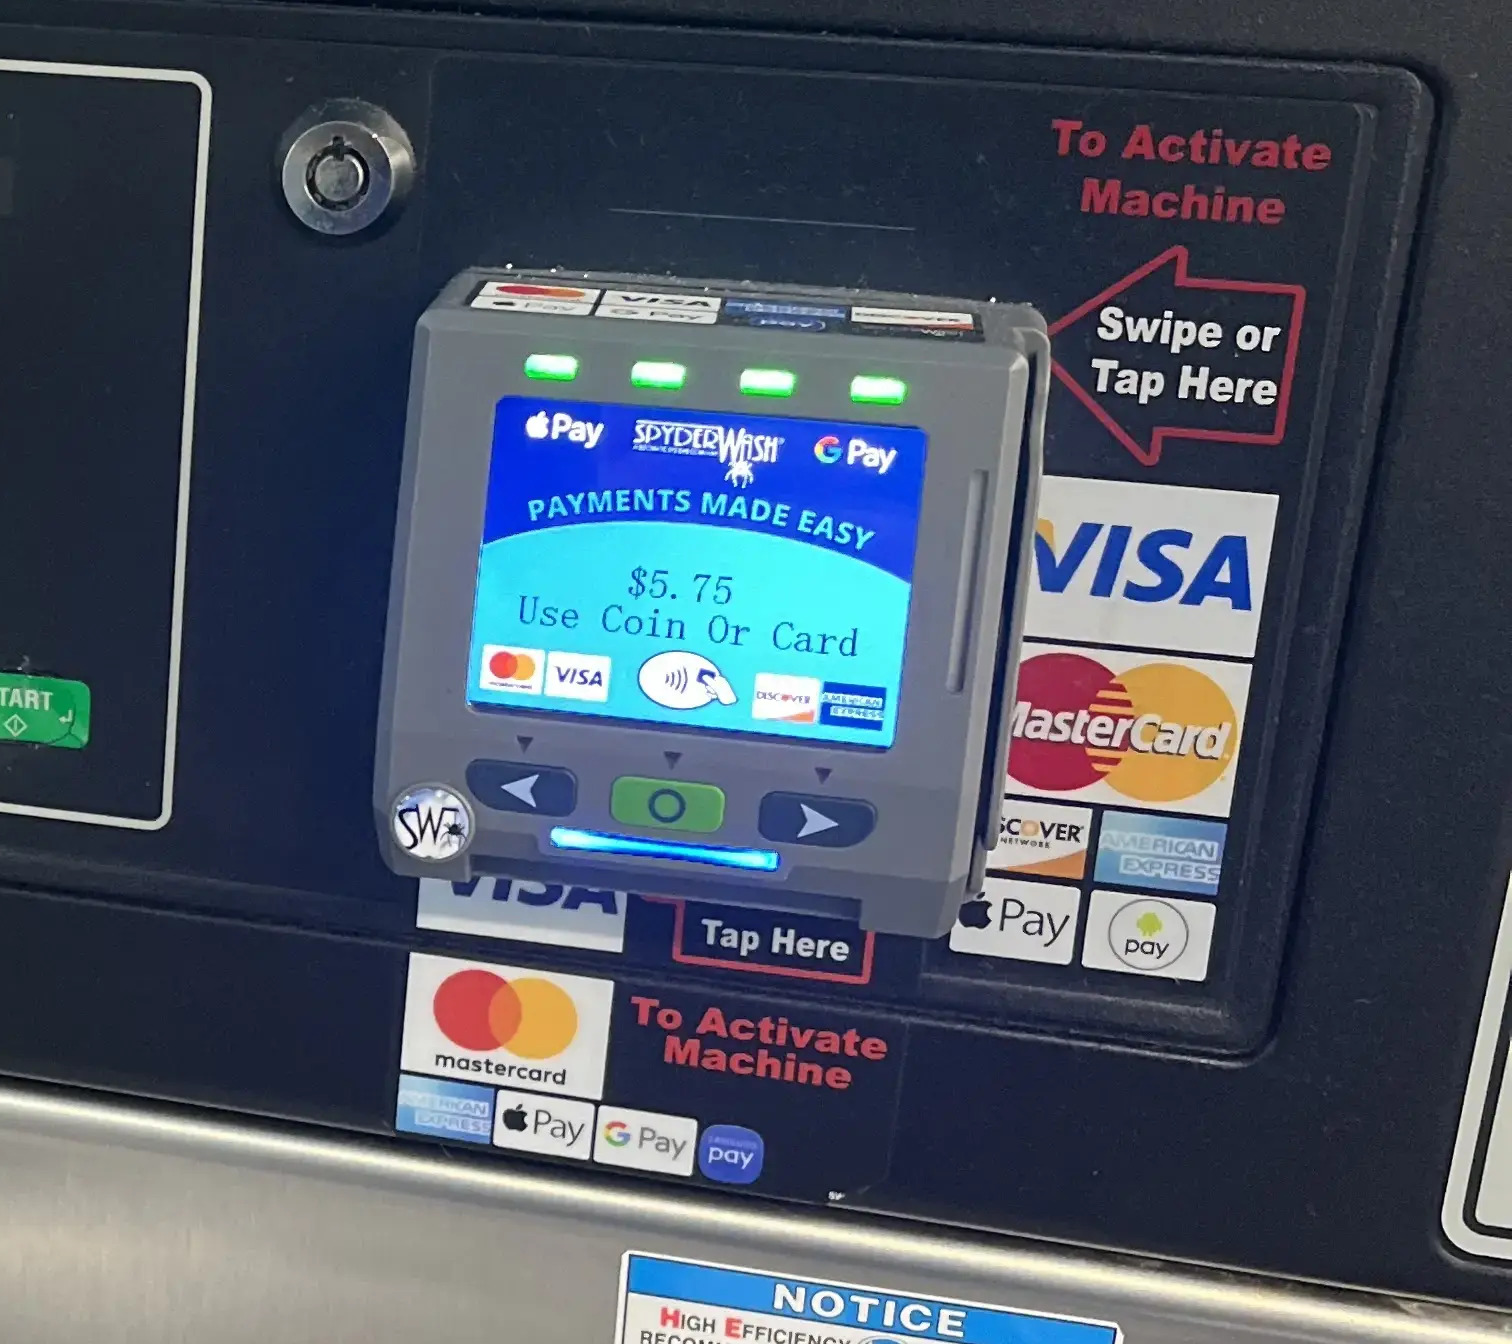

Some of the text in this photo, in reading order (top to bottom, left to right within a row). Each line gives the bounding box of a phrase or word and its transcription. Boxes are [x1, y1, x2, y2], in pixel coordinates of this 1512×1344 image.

[1052, 119, 1332, 171] To Activate
[1081, 178, 1286, 225] Machine
[1097, 306, 1281, 353] Swipe or
[1091, 359, 1278, 405] Tap Here
[552, 413, 604, 448] Pay
[848, 439, 897, 474] Pay
[527, 489, 876, 551] PAYMENTS MADE EASY
[628, 564, 734, 605] $5.75
[1033, 521, 1252, 611] VISA
[518, 595, 859, 657] Use Coin Or Card
[553, 665, 603, 687] VISA
[756, 690, 810, 705] DISCOVER
[1101, 831, 1215, 857] AMERICAN
[1123, 859, 1219, 880] EXPRESS
[701, 918, 850, 961] Tap Here
[999, 898, 1070, 947] Pay
[1124, 939, 1169, 959] pay
[631, 996, 888, 1060] To Activate
[435, 1053, 567, 1085] mastercard
[664, 1035, 852, 1089] Machine
[533, 1110, 585, 1147] Pay
[639, 1127, 687, 1160] Pay
[708, 1147, 754, 1169] pay
[660, 1307, 716, 1333] HIGH
[773, 1283, 967, 1338] NOTICE
